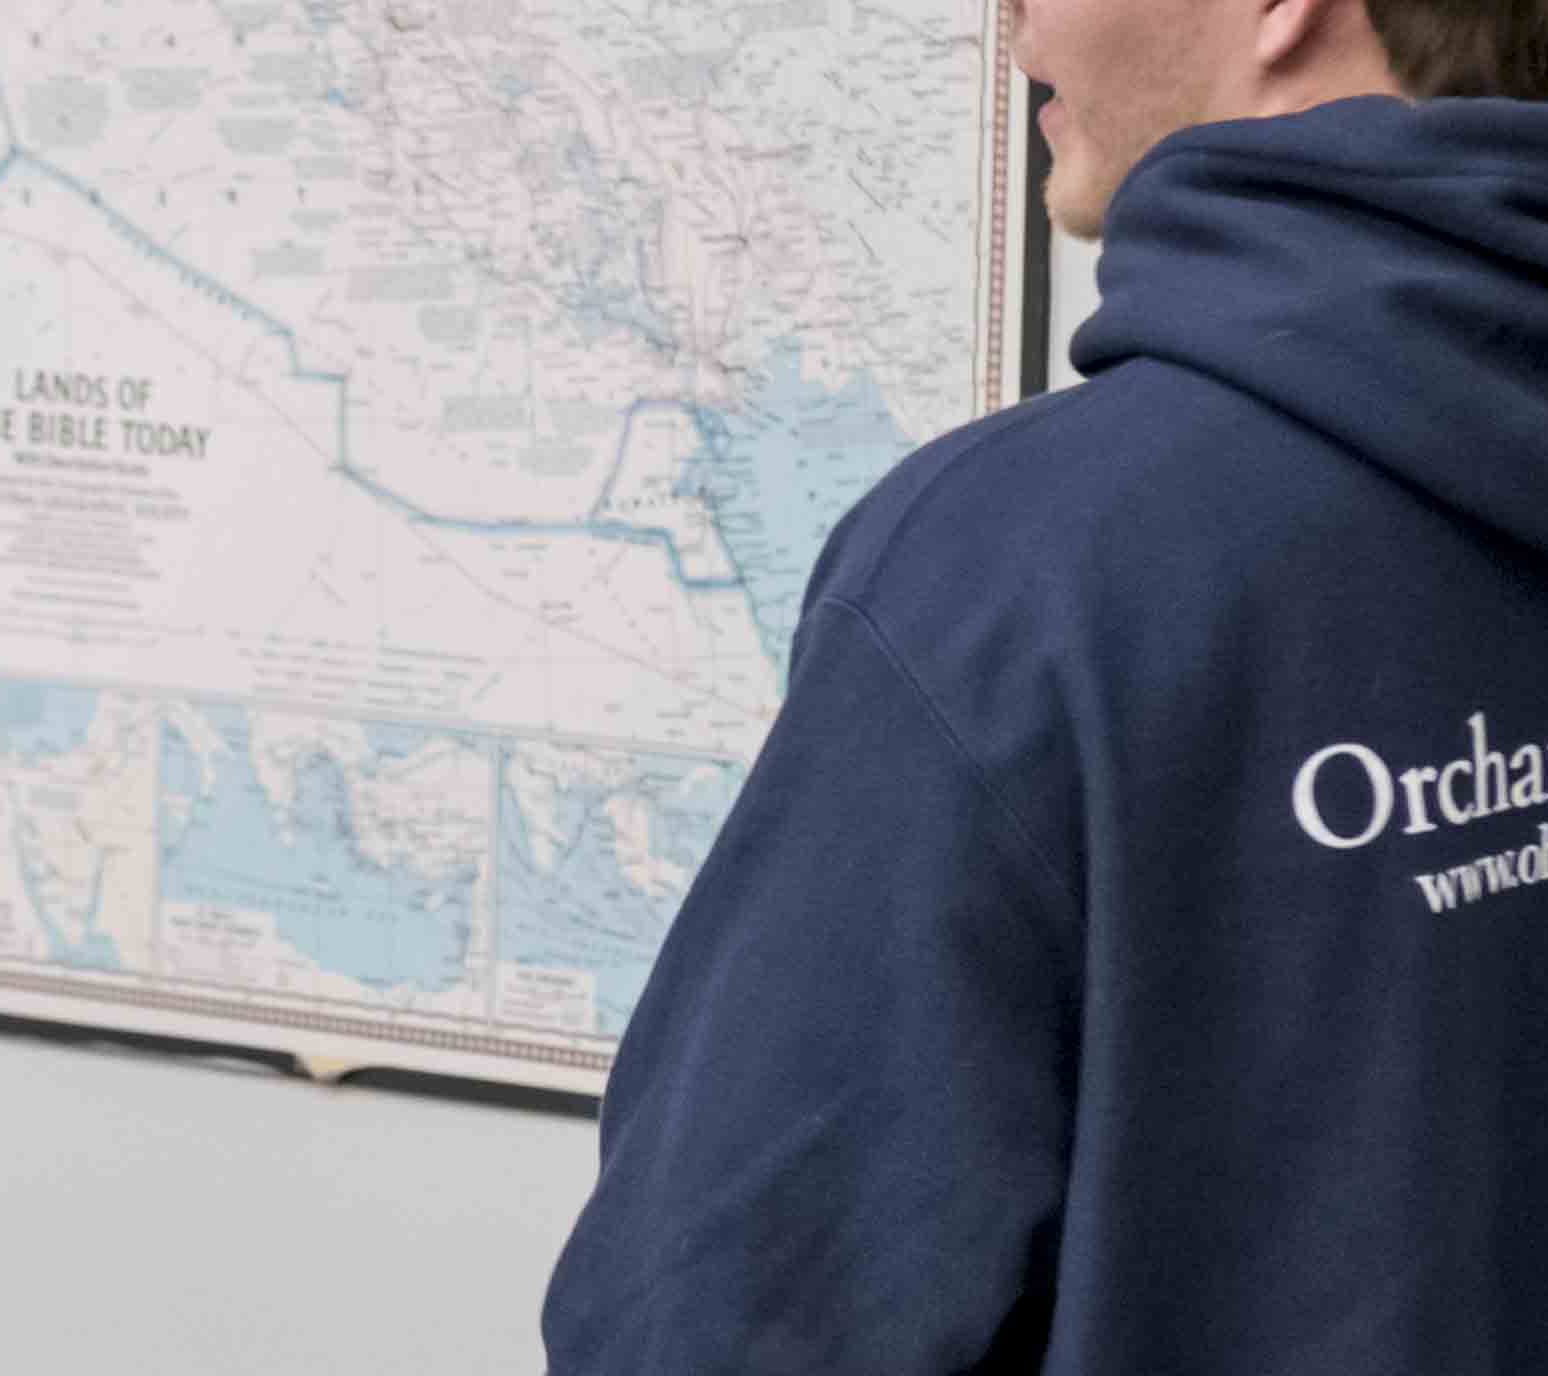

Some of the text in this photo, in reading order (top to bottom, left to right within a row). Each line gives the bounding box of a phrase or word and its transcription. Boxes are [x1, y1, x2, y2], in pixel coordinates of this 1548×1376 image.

[14, 367, 153, 411] LANDS OF
[27, 411, 109, 451] BIBLE
[120, 417, 212, 460] TODAY
